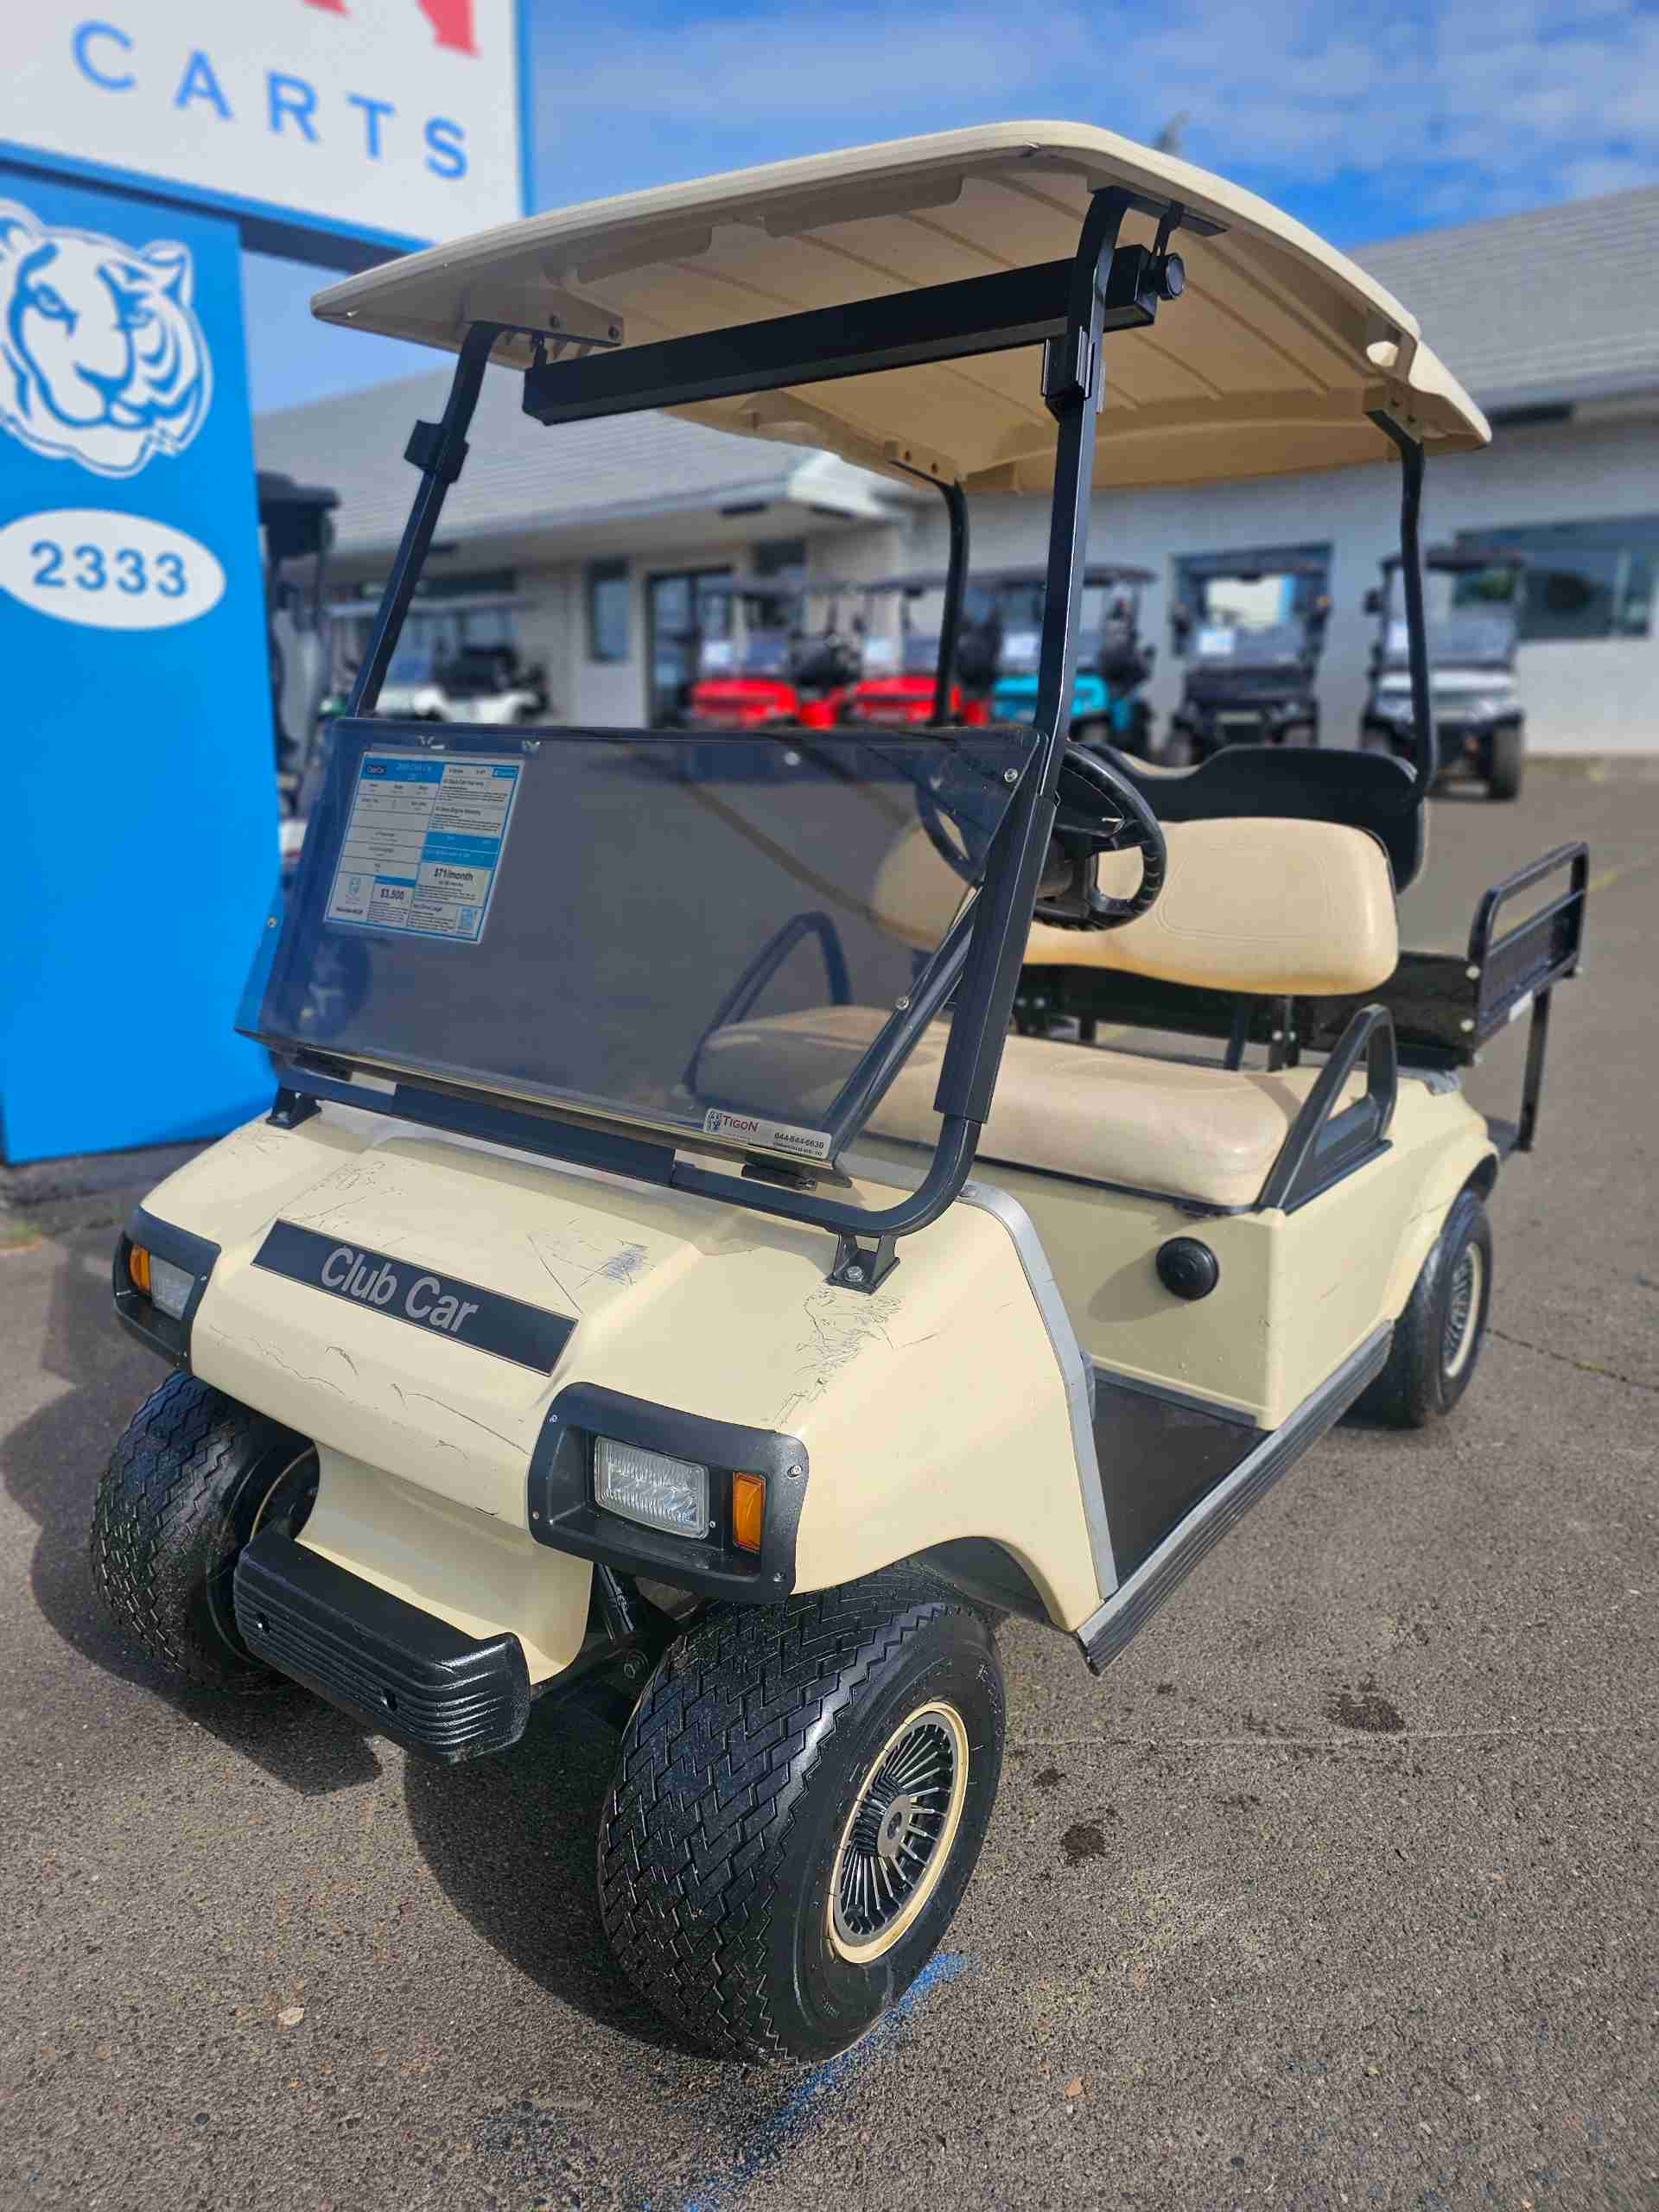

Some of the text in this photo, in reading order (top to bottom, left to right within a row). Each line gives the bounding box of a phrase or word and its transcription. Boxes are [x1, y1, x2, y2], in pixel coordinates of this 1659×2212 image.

[71, 18, 469, 181] CARTS
[30, 539, 188, 599] 2333
[320, 1244, 480, 1333] Club Car
